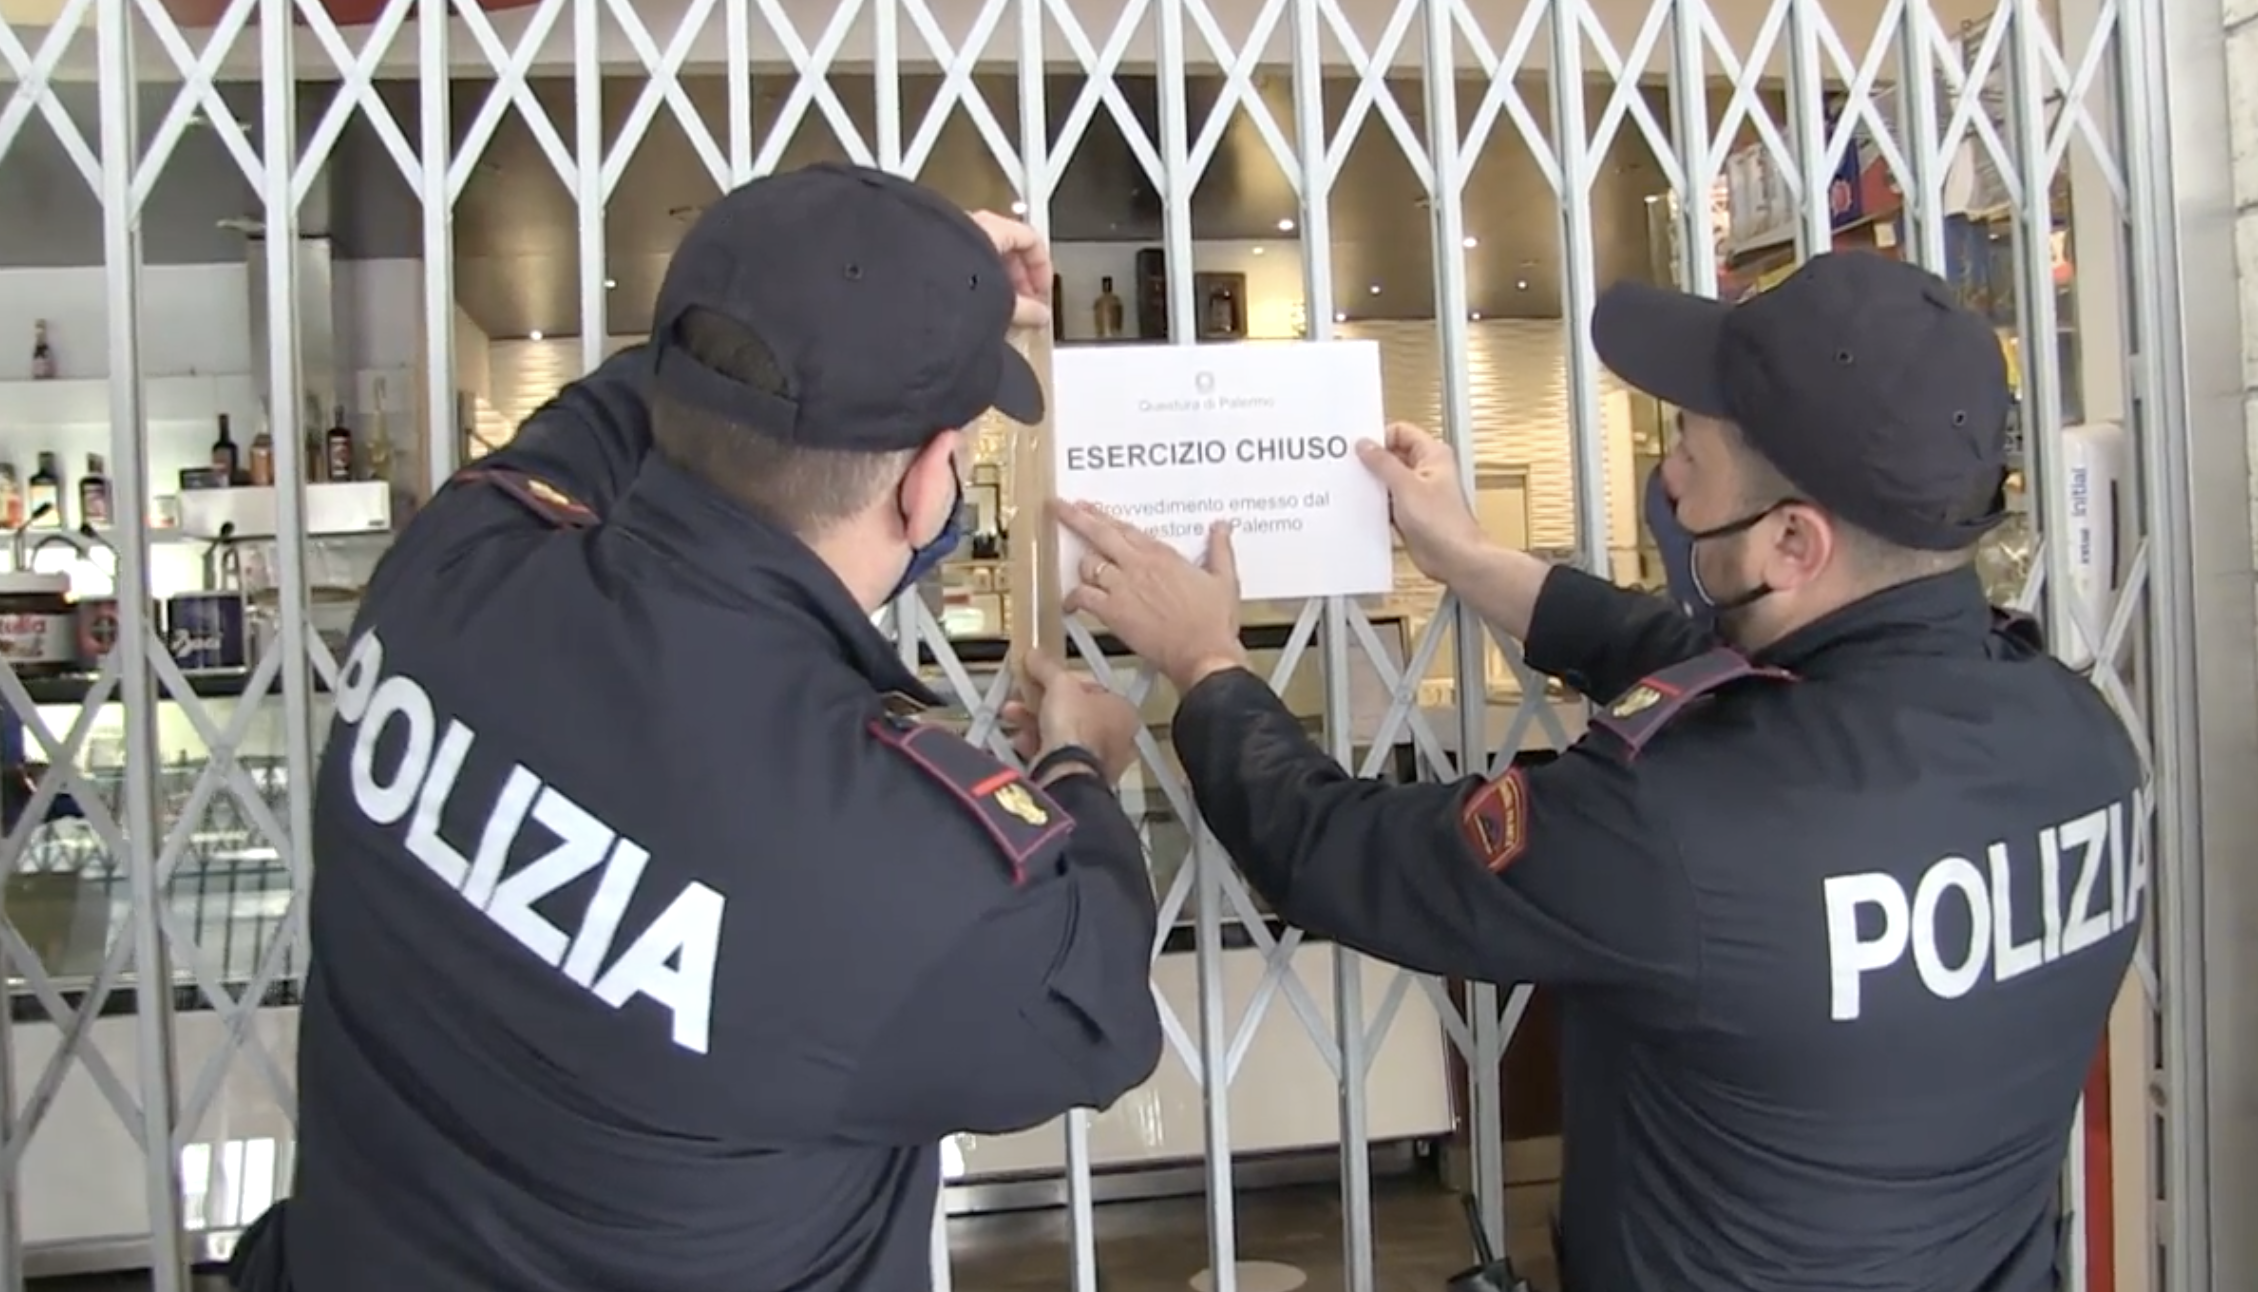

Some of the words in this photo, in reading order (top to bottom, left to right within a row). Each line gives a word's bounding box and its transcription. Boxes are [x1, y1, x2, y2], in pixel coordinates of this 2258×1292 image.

[1138, 400, 1200, 412] Questura
[1203, 398, 1216, 410] di
[1218, 395, 1275, 409] Palermo
[1067, 440, 1226, 470] ESERCIZIO
[1236, 435, 1349, 463] CHIUSO
[1229, 494, 1299, 511] emesso
[1303, 491, 1331, 508] dal
[2071, 467, 2088, 517] initial
[1231, 515, 1303, 534] Palermo
[336, 625, 726, 1055] POLIZIA
[1824, 787, 2149, 1021] POLIZIA
